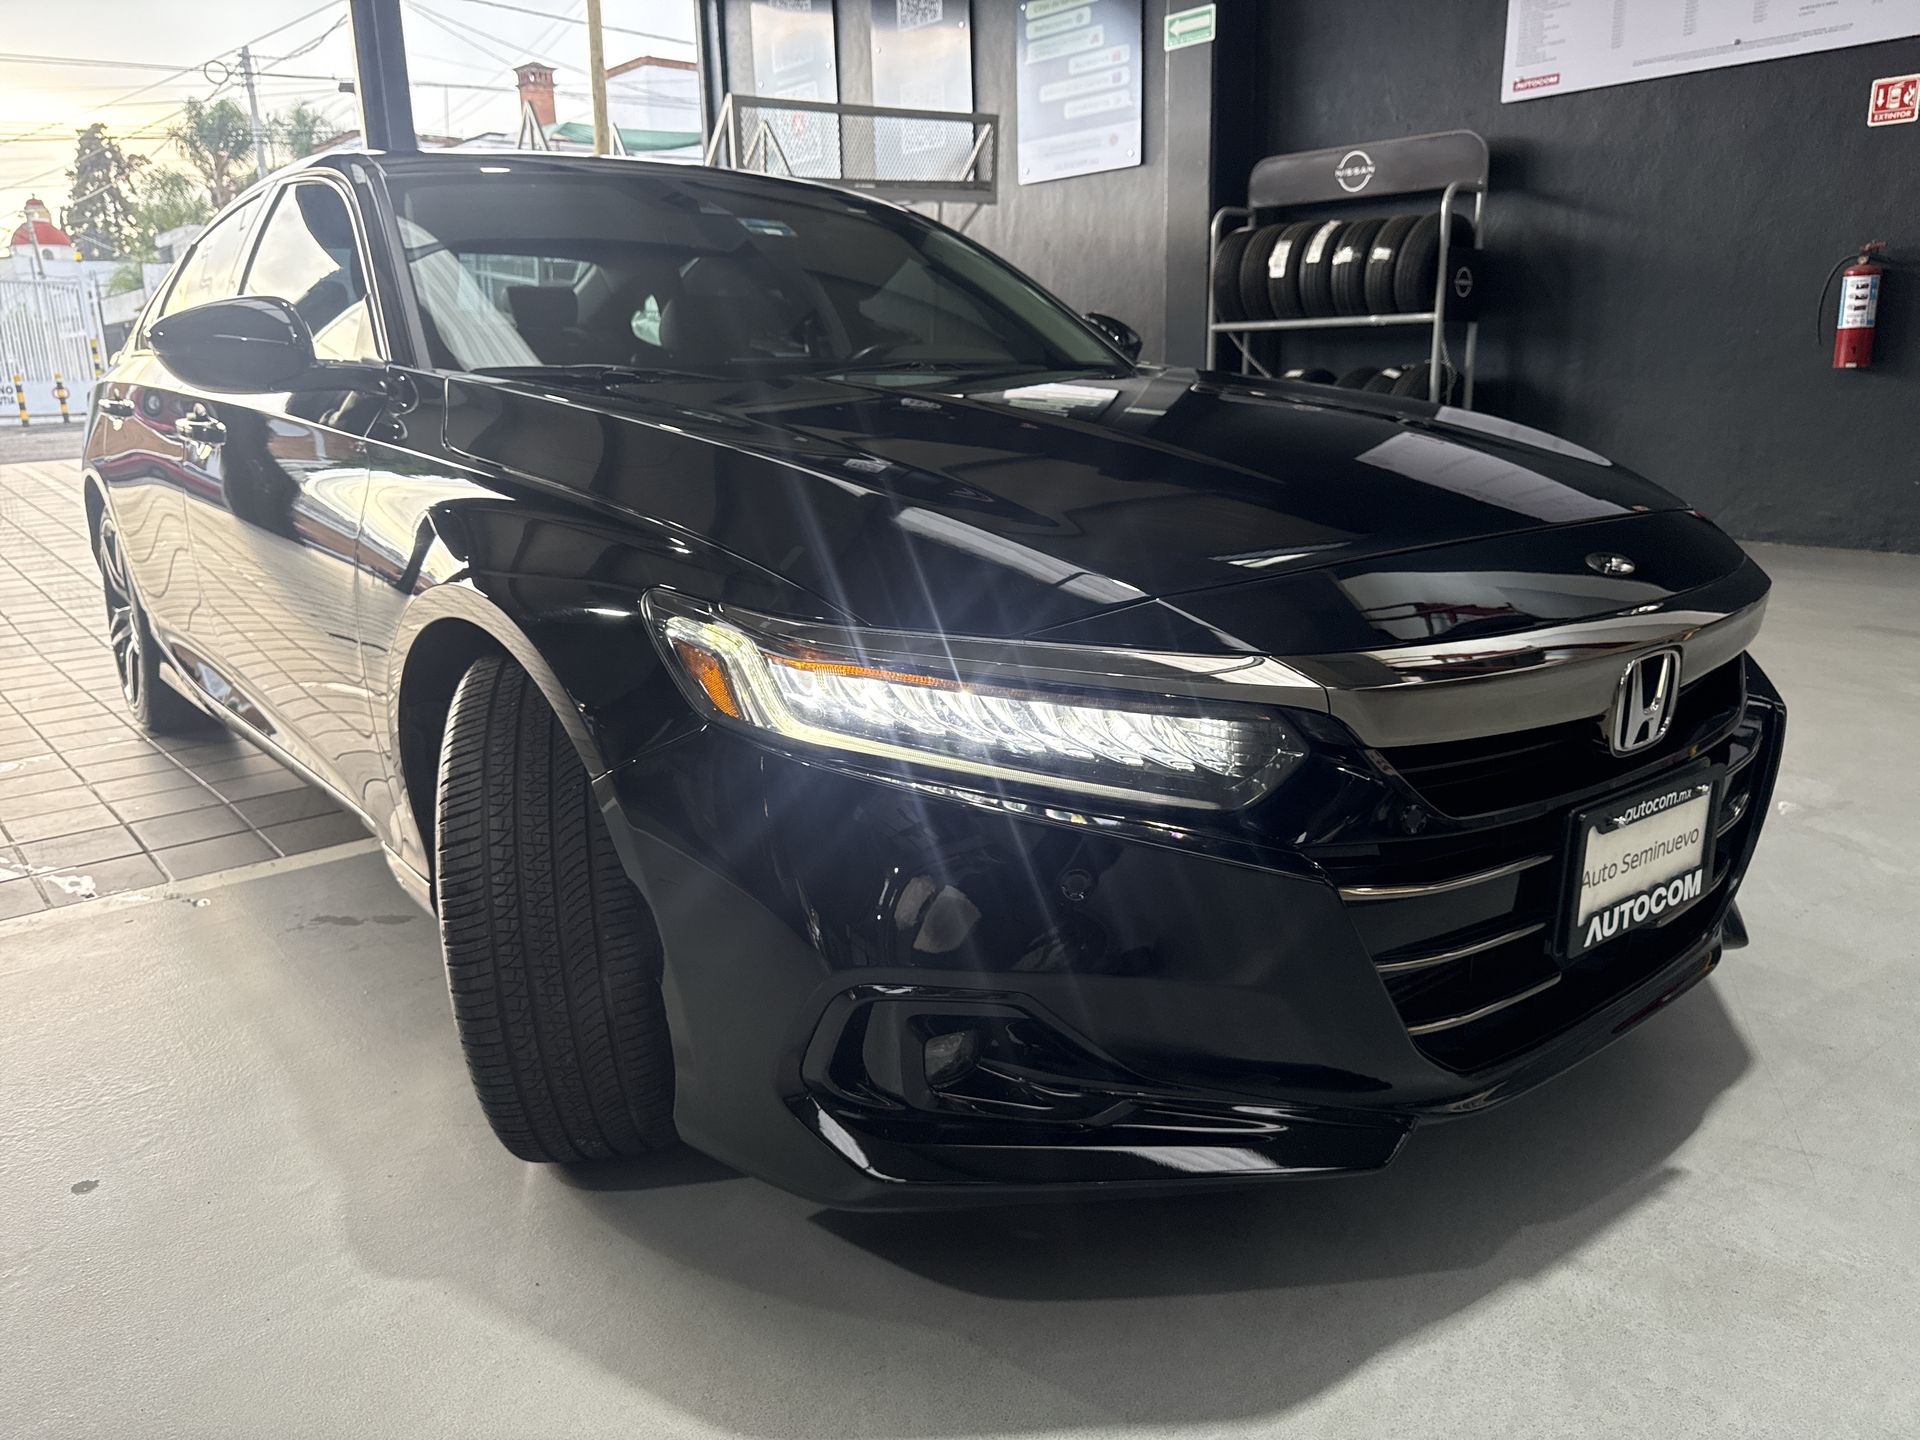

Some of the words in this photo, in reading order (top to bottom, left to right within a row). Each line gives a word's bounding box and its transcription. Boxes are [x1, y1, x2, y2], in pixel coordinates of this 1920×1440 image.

[1873, 110, 1912, 121] EXTINTOR
[1335, 166, 1375, 178] NISSAN
[1624, 788, 1692, 824] autocom.mx
[1582, 862, 1618, 888] Auto
[1621, 828, 1699, 875] Seminuevo
[1583, 868, 1703, 948] AUTOCOM
